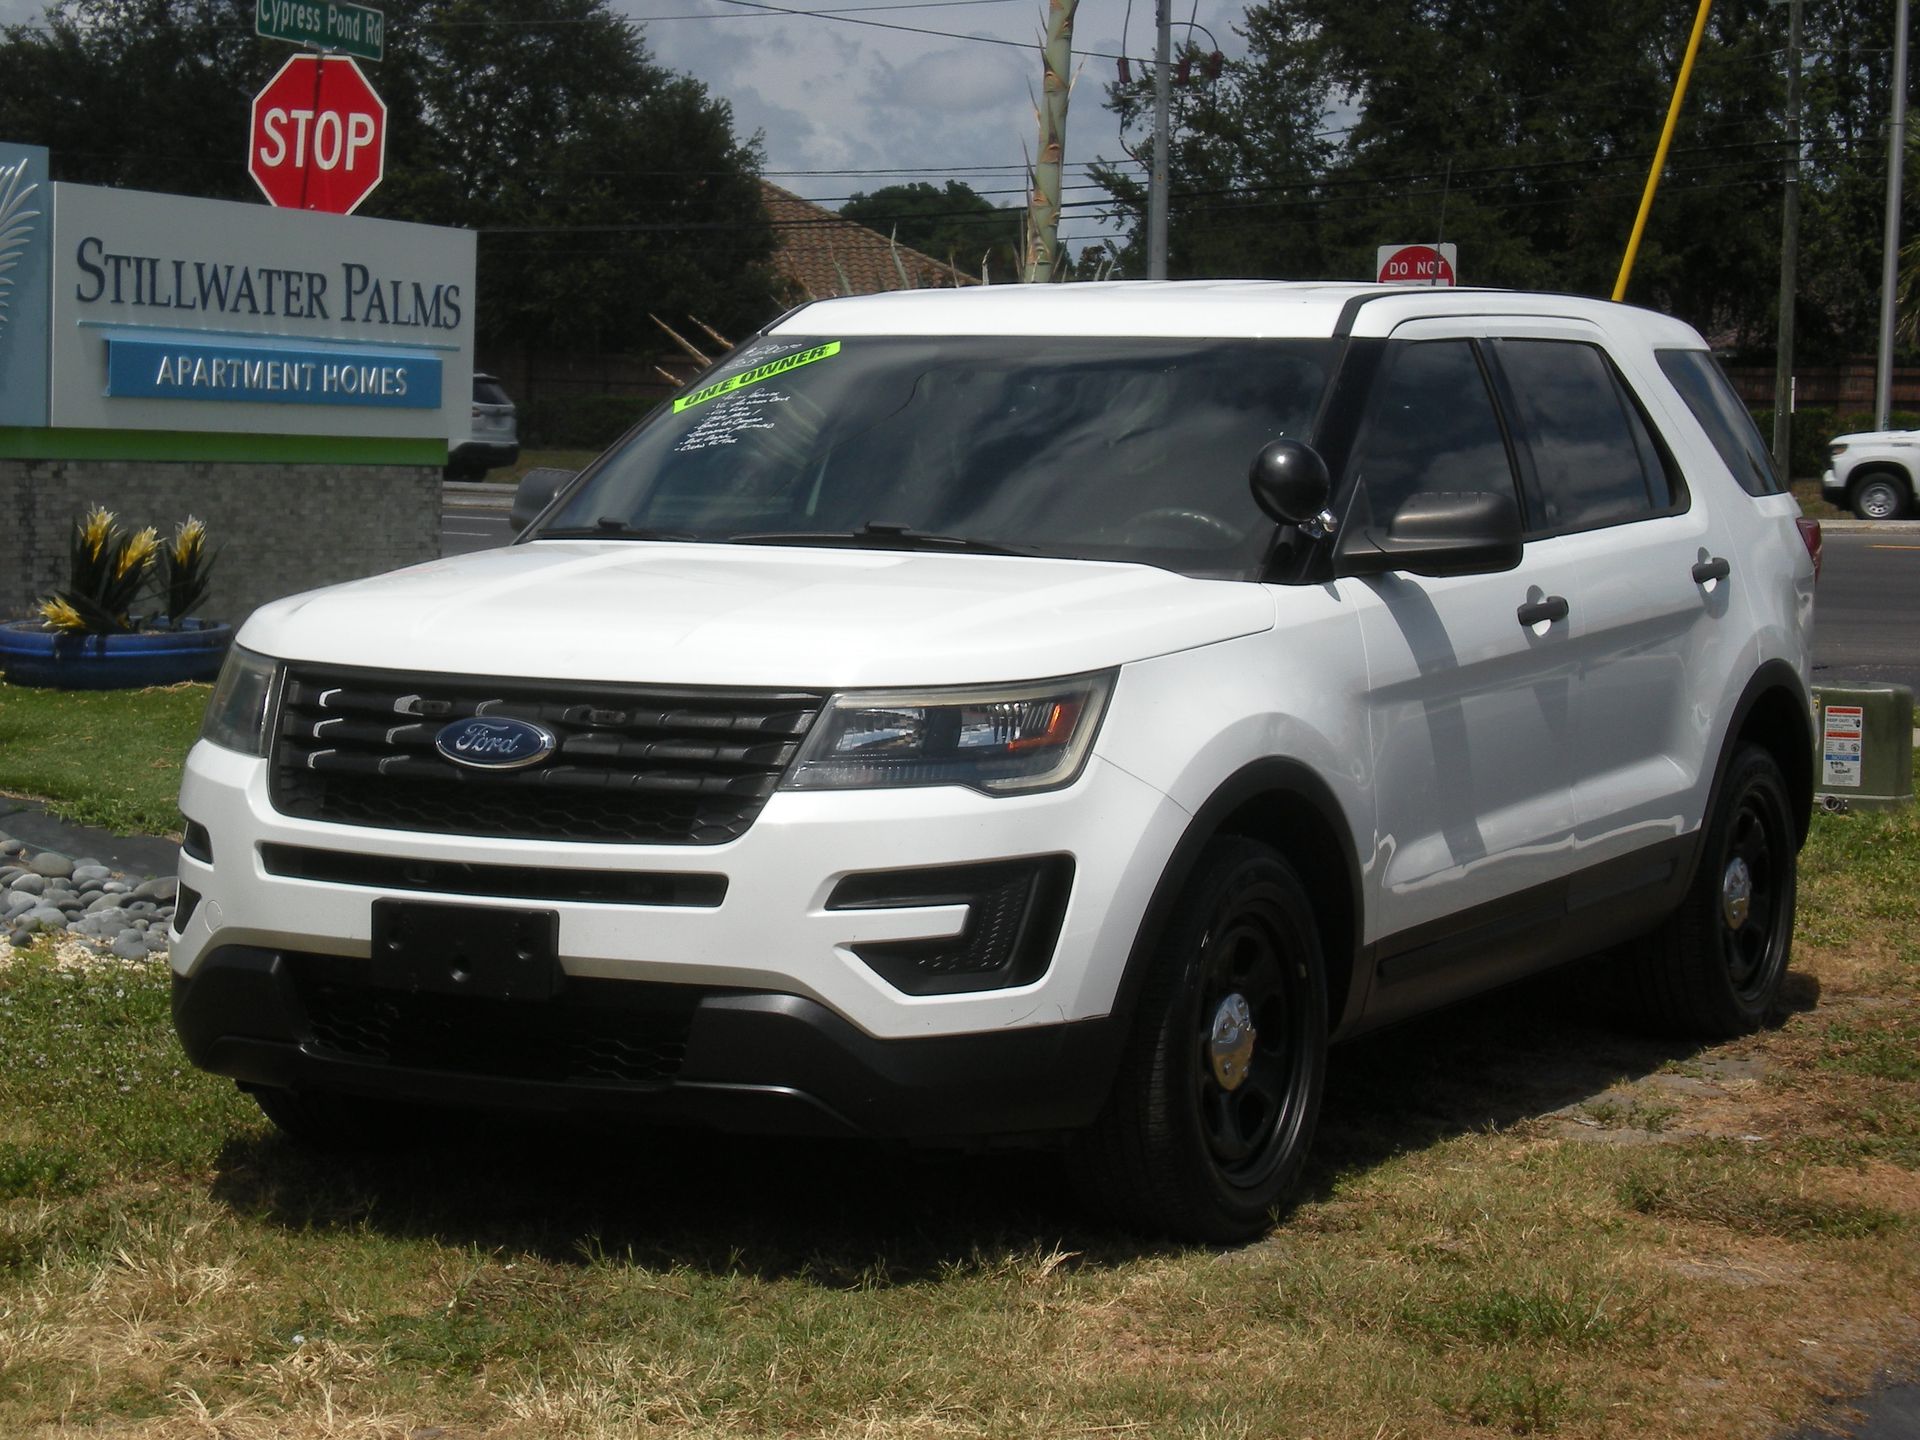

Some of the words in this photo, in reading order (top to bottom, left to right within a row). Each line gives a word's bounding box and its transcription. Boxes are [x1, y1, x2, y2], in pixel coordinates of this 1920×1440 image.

[260, 0, 320, 32] Cypress
[327, 4, 360, 41] Pond
[365, 13, 381, 46] Rd
[260, 108, 375, 171] STOP
[76, 236, 328, 320] STILLWATER
[341, 262, 462, 330] PALMS
[1389, 262, 1408, 275] DO
[1417, 261, 1444, 275] NOT
[156, 355, 316, 391] APARTMENT
[323, 364, 408, 396] HOMES
[683, 378, 736, 406] ONE
[739, 345, 829, 384] OWNER
[456, 722, 523, 753] Ford
